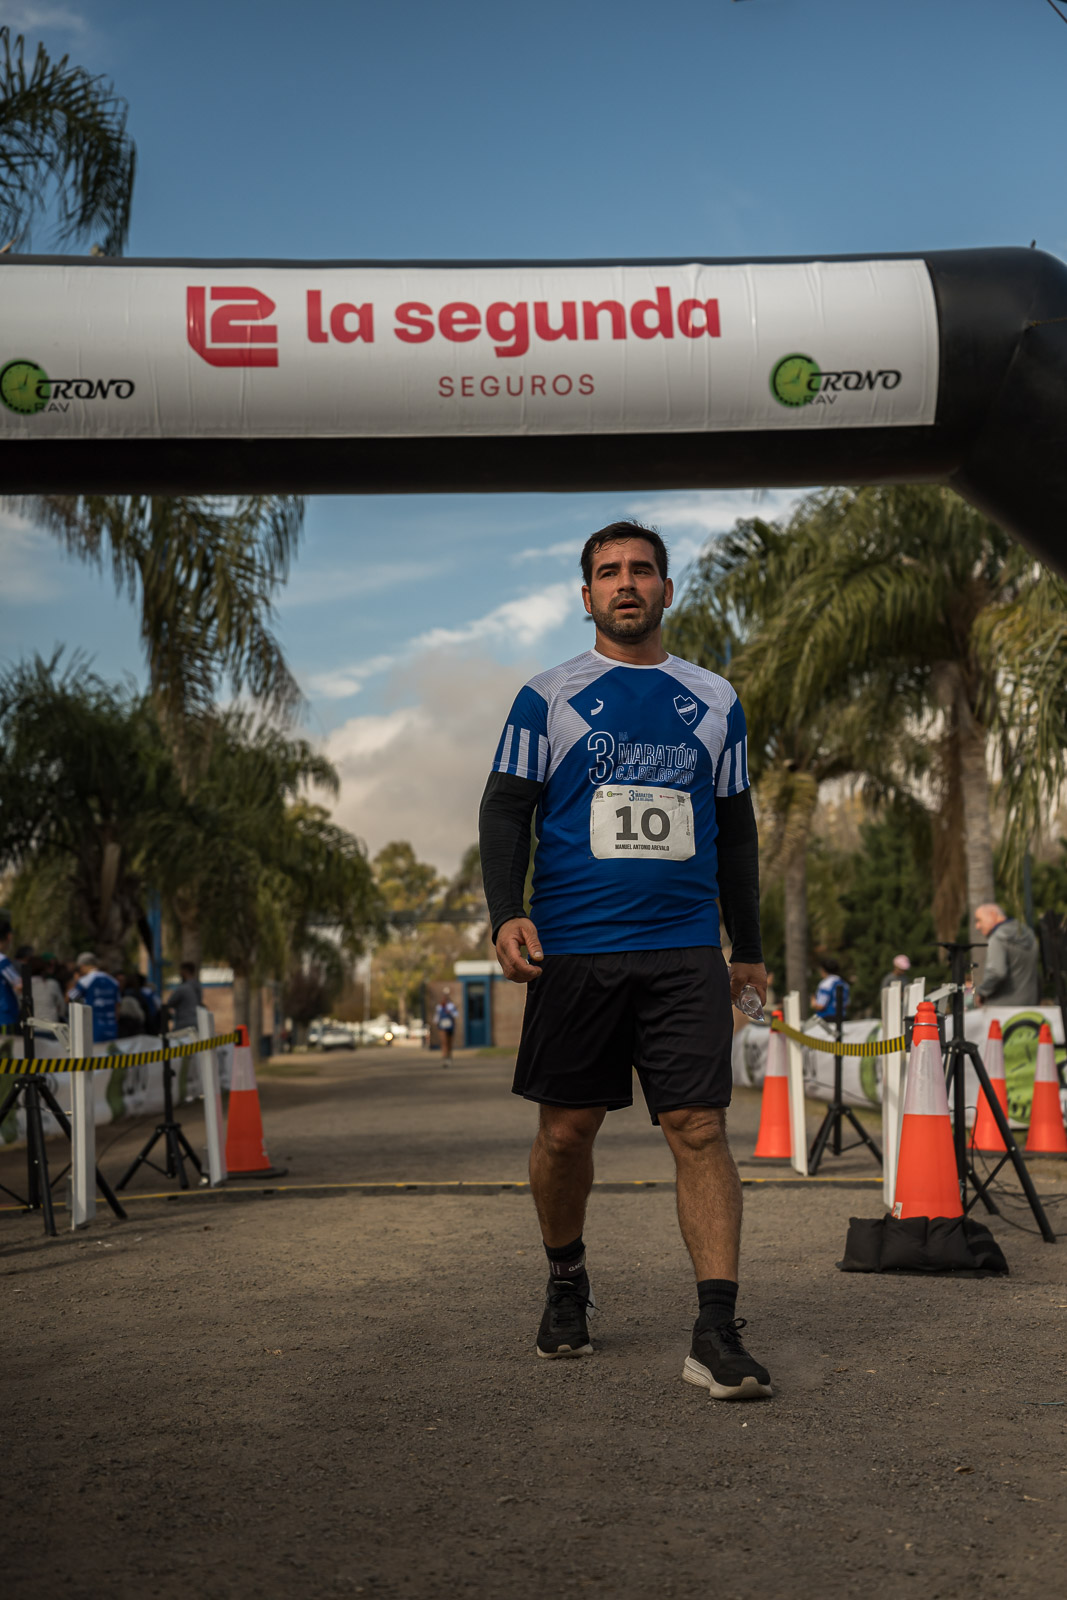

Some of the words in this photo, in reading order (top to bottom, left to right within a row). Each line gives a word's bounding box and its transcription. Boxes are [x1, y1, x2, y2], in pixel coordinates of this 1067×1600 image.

[306, 289, 375, 344] la
[393, 286, 721, 358] segunda
[35, 378, 135, 400] CRONO
[438, 373, 595, 398] SEGUROS
[807, 370, 903, 392] CRONO
[34, 402, 70, 413] RAV
[803, 394, 837, 405] RAV
[587, 731, 615, 786] 3
[618, 742, 698, 771] MARATÓN
[615, 805, 671, 842] 10
[651, 844, 670, 852] AREVALO
